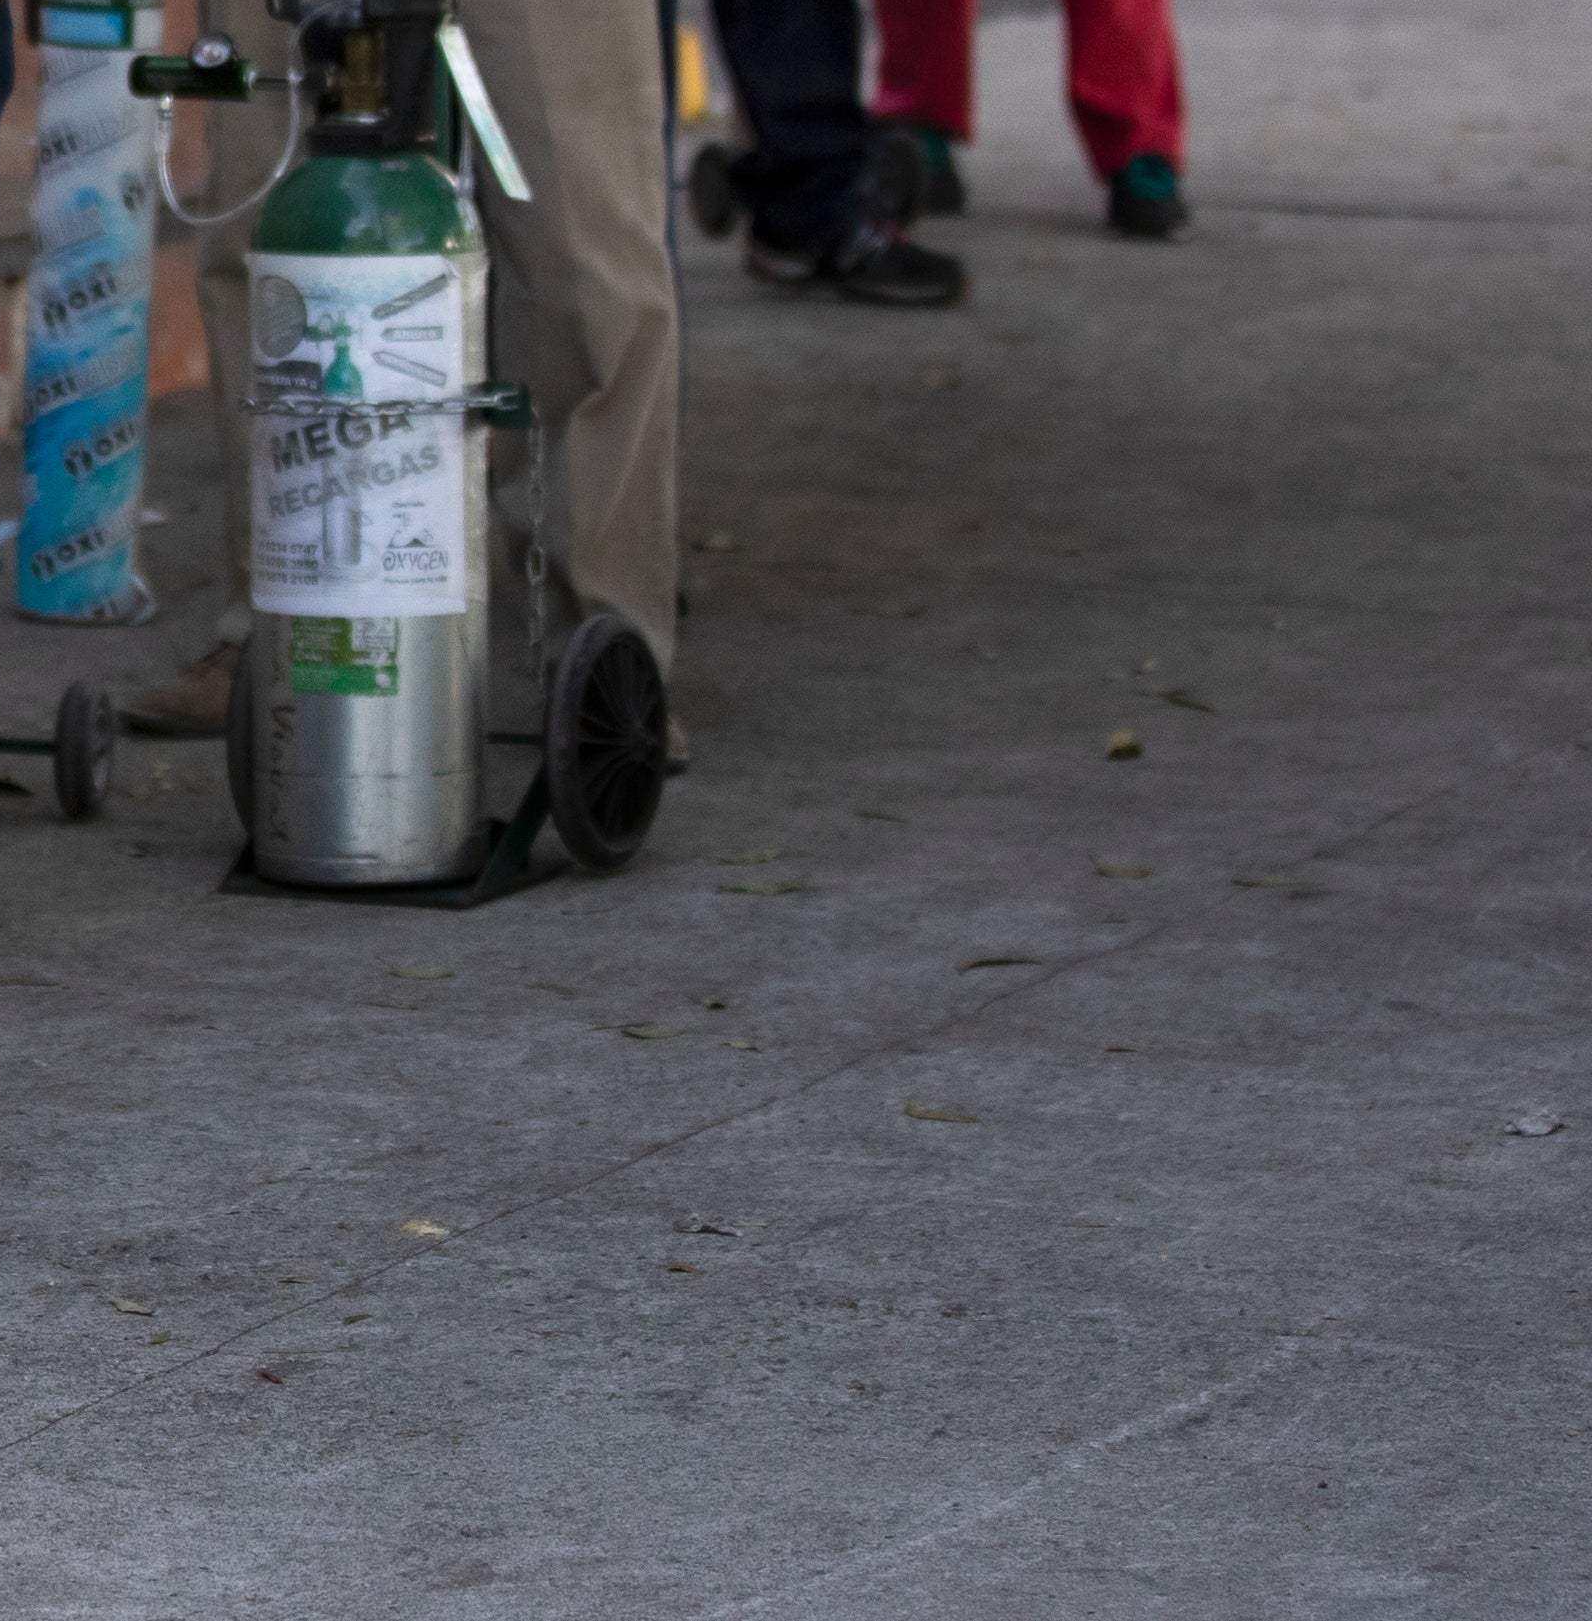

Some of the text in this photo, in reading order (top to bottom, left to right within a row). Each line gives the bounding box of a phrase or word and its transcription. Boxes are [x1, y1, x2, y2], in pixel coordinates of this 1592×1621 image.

[269, 413, 415, 474] MEGA
[267, 445, 442, 520] RECARGAS
[381, 550, 450, 573] OXYGEN
